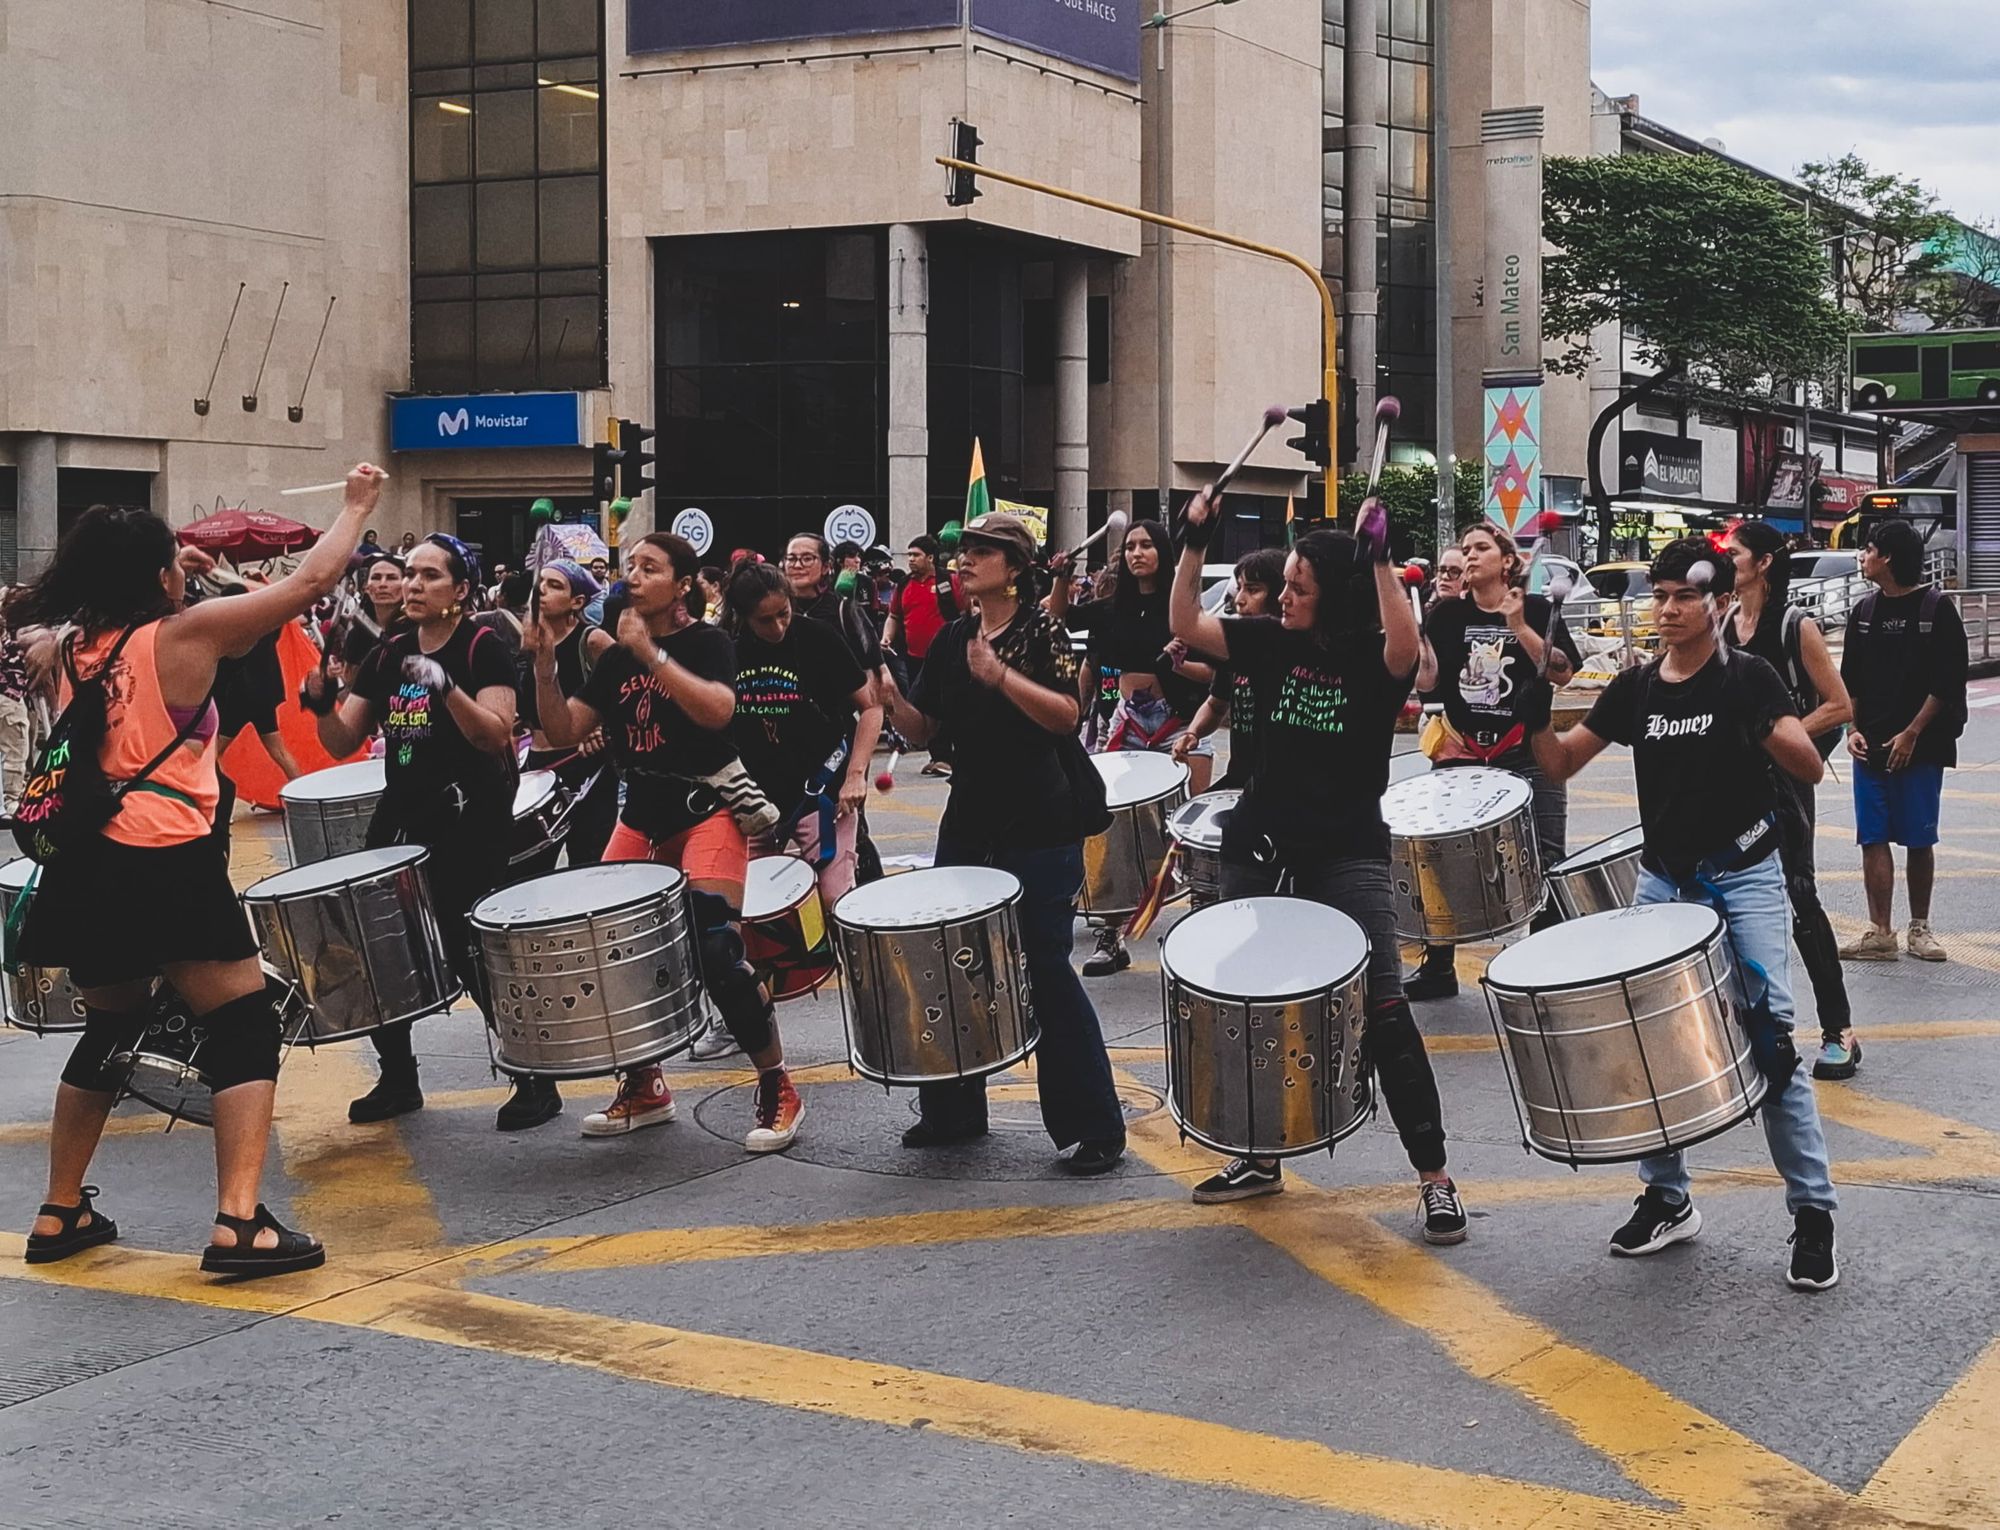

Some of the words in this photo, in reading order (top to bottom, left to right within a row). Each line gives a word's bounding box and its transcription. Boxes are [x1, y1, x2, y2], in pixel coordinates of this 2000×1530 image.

[1086, 0, 1116, 22] HACES
[1501, 254, 1520, 314] Mateo
[1501, 320, 1520, 356] San
[475, 414, 529, 428] Movistar
[1660, 464, 1669, 482] EL
[1669, 465, 1700, 486] PALACIO
[681, 525, 704, 542] 5G
[835, 522, 865, 540] 5G
[1645, 713, 1713, 740] Honey
